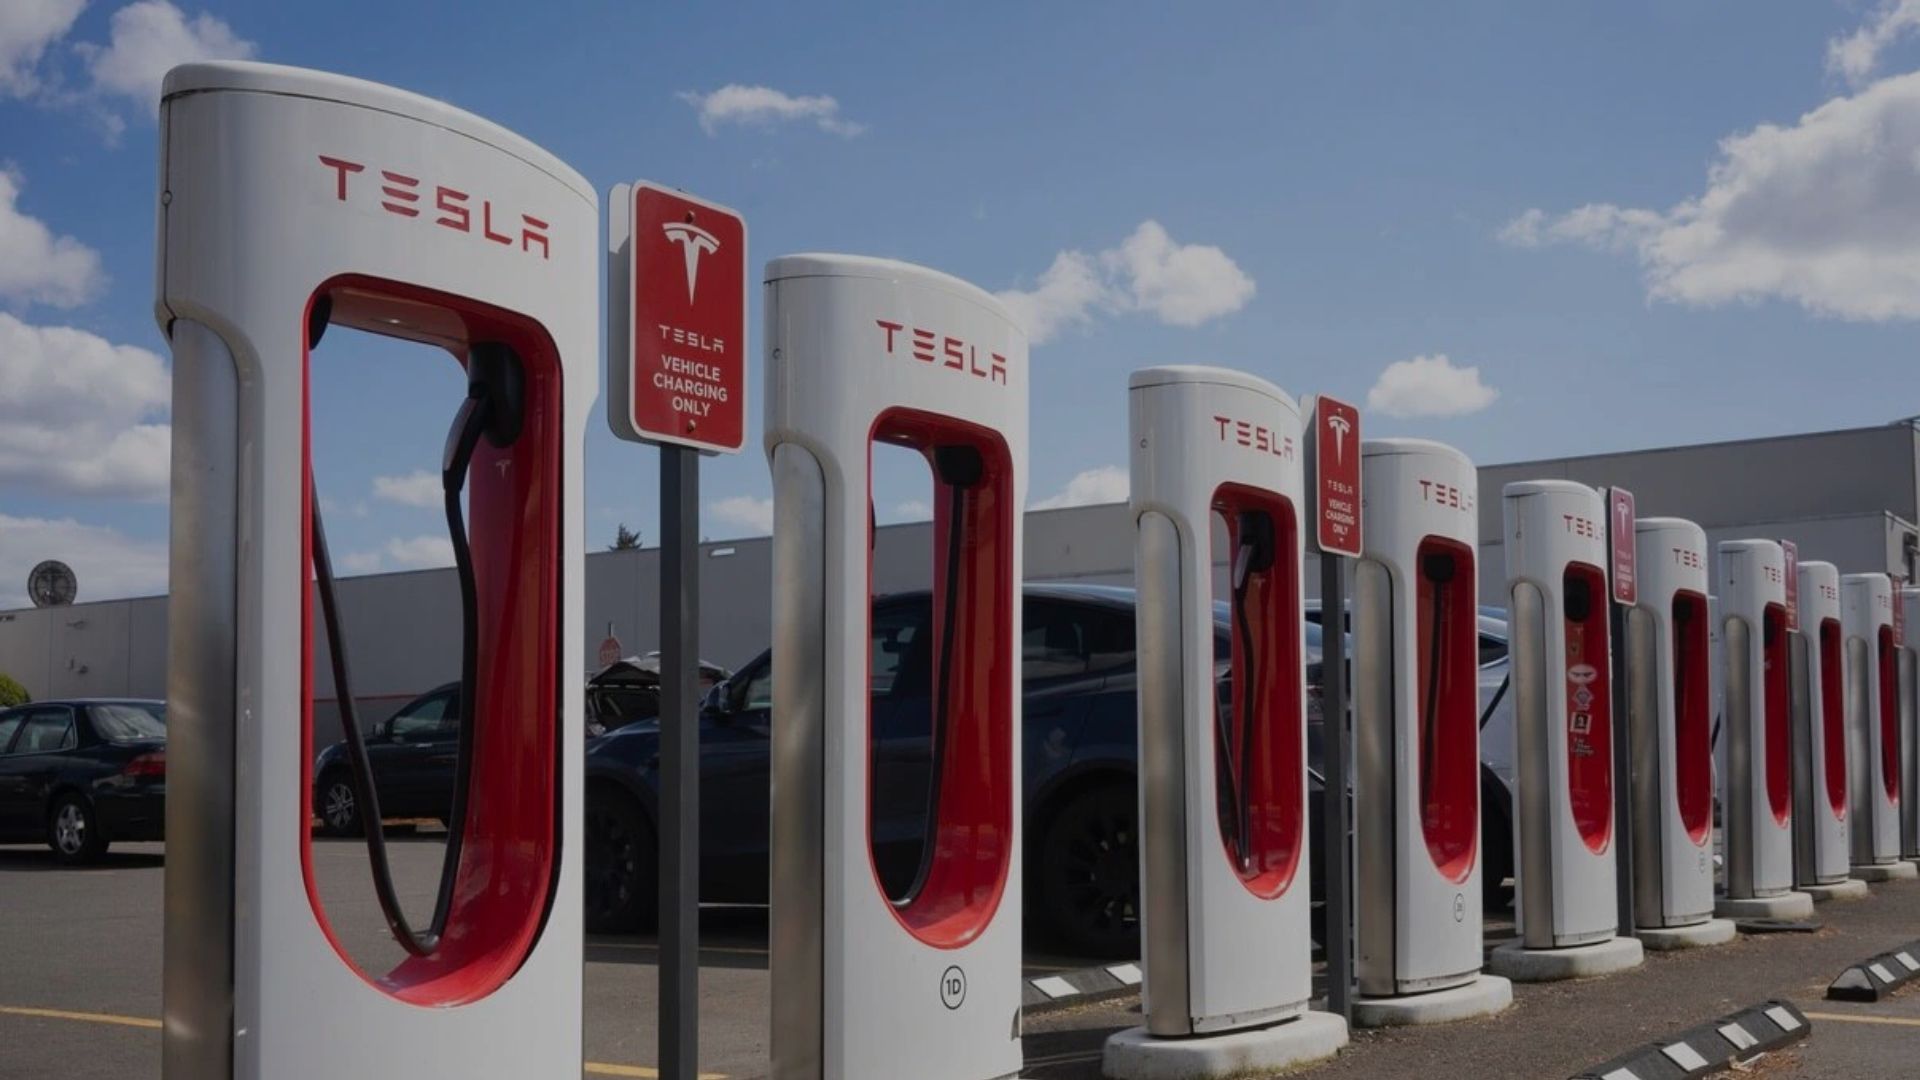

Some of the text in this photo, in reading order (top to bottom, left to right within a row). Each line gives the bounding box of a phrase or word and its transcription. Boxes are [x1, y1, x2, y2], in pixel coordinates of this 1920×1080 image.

[318, 155, 549, 259] TESLA
[658, 324, 724, 354] TESLA
[876, 320, 1007, 385] TESLA
[661, 354, 721, 382] VEHICLE
[653, 372, 728, 402] CHARGING
[672, 395, 710, 416] ONLY
[1213, 415, 1295, 463] TESLA
[945, 978, 962, 995] 1D
